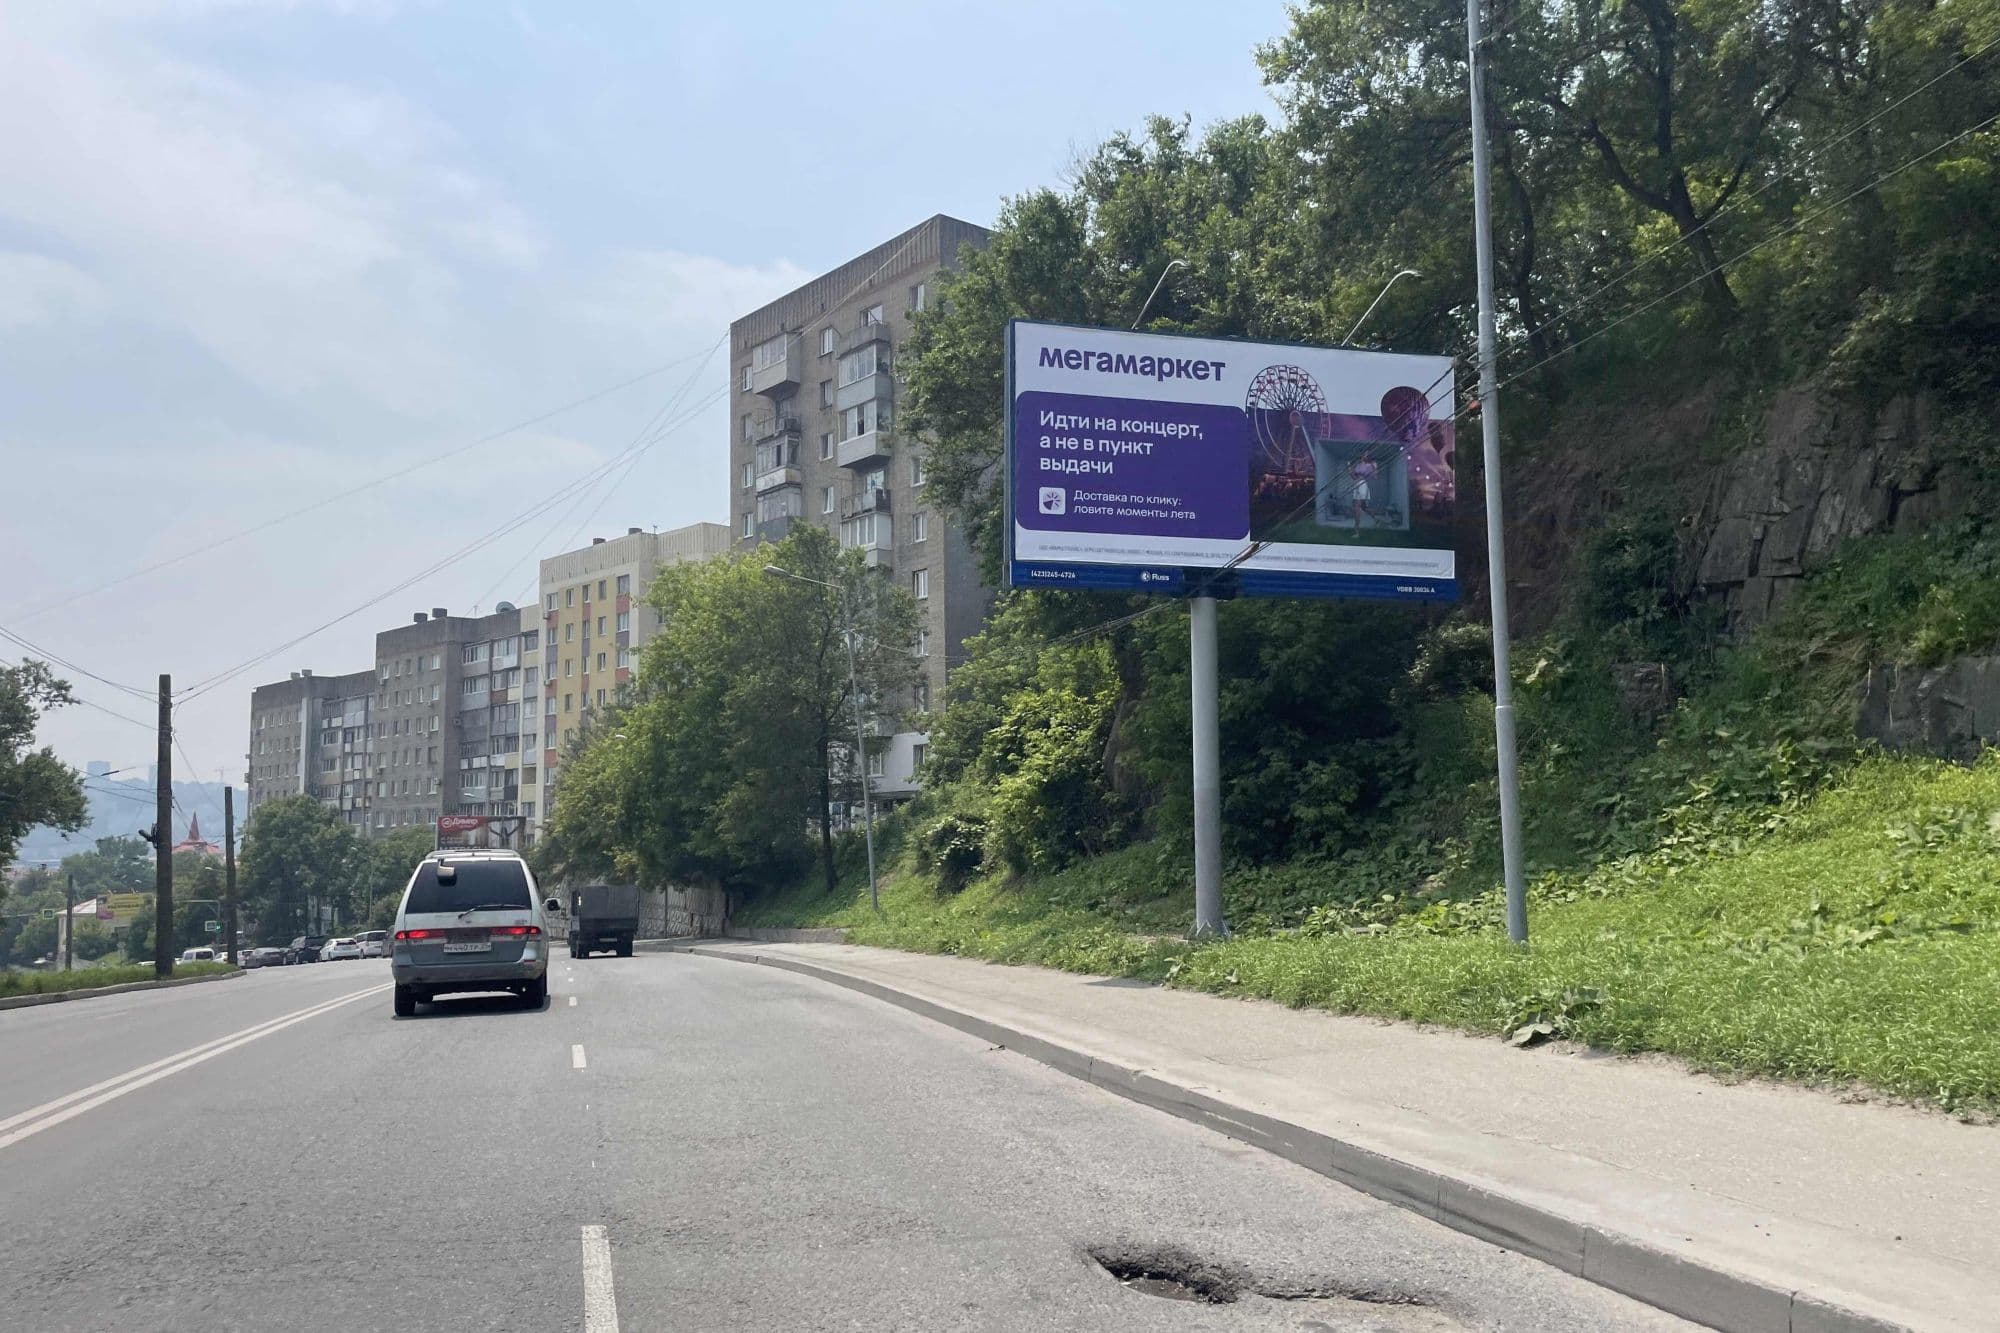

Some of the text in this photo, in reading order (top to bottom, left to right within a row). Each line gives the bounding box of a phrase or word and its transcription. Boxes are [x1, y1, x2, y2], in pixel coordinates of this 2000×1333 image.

[1039, 347, 1226, 382] мегамаркет
[1040, 410, 1204, 440] Идти на концерт,
[1039, 435, 1154, 456] а не в пункт
[1040, 457, 1114, 475] выдачи
[1073, 490, 1183, 507] Доставка по клику:
[1073, 504, 1197, 520] ловите моменты лета
[1151, 573, 1170, 581] Russ
